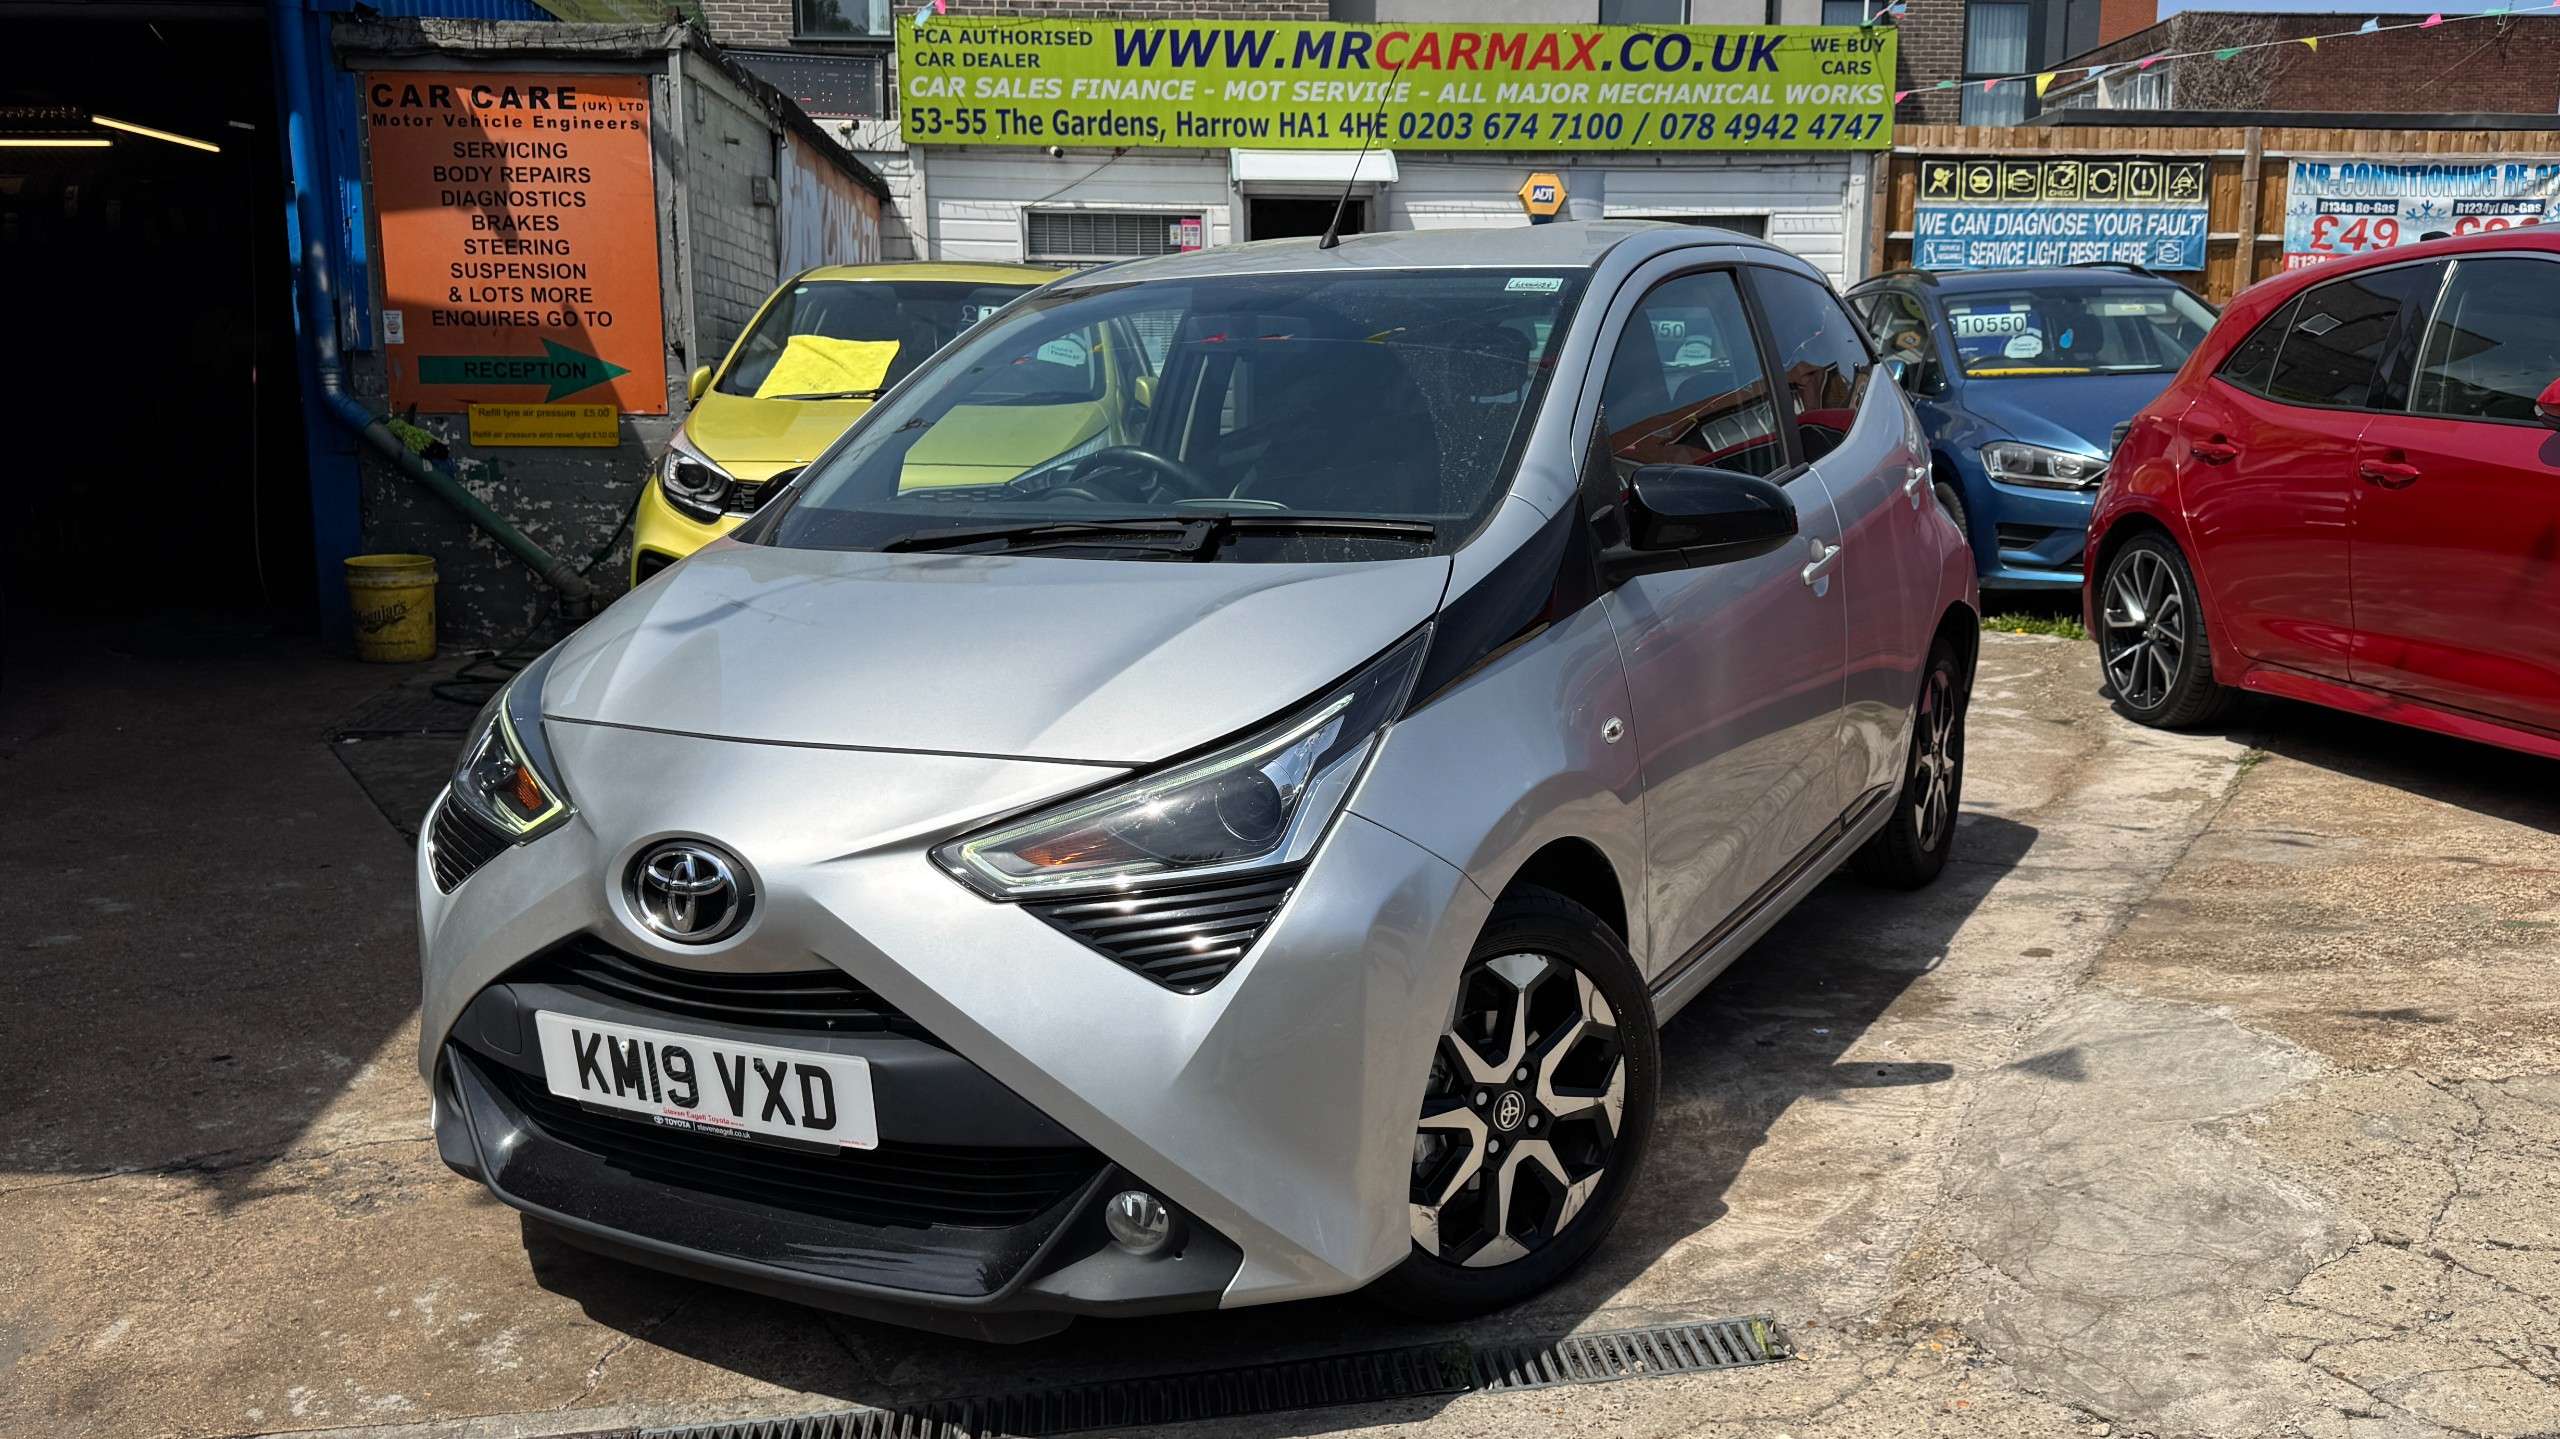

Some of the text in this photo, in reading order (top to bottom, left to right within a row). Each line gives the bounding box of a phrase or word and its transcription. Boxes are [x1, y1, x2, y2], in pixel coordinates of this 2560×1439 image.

[915, 30, 1092, 46] FCA AUTHORISED
[1811, 38, 1885, 53] WE BUY
[1113, 28, 1787, 73] WWW.MRCARMAX.CO.UK
[915, 51, 1041, 68] CAR DEALER
[1822, 60, 1872, 76] CARS
[371, 84, 644, 113] CAR CARE (UK) LTD
[910, 77, 969, 99] CAR
[975, 78, 1063, 100] SALES
[1072, 79, 1195, 101] FINANCE
[1225, 81, 1285, 102] MOT
[1292, 81, 1410, 103] SERVICE
[1437, 83, 1487, 103] ALL
[1496, 83, 1586, 104] MAJOR
[1598, 83, 1775, 106] MECHANICAL
[1785, 84, 1884, 106] WORKS
[372, 114, 640, 132] Motor Vehicle Engineers
[911, 107, 987, 135] 53-55
[996, 109, 1043, 136] The
[1053, 109, 1167, 144] Gardens,
[1176, 111, 1270, 138] Harrow
[1279, 112, 1329, 139] HA1
[1340, 112, 1388, 139] 4HE
[1399, 112, 1473, 140] 0203
[1484, 112, 1539, 140] 674
[1549, 112, 1623, 140] 7100
[1660, 112, 1715, 140] 078
[1726, 112, 1799, 140] 4942
[1808, 112, 1884, 140] 4747
[453, 142, 568, 159] SERVICING
[433, 166, 591, 184] BODY REPAIRS
[441, 191, 586, 208] DIAGNOSTICS
[1533, 186, 1555, 201] ADT
[2320, 201, 2396, 213] R134a Re-Gas
[2500, 202, 2542, 213] Re-Gas
[472, 215, 560, 232] BRAKES
[1919, 213, 2206, 235] WE CAN DIAGNOSE YOUR FAULT
[2311, 215, 2399, 250] £49
[464, 239, 570, 256] STEERING
[1970, 241, 2148, 265] SERVICE LIGHT RESET HERE
[450, 262, 587, 279] SUSPENSION
[448, 286, 593, 303] & LOTS MORE
[432, 310, 612, 328] ENQUIRES GO TO
[1961, 316, 2025, 334] 10550
[464, 362, 587, 379] RECEPTION
[479, 408, 501, 417] Refill
[572, 1028, 837, 1131] KM19 VXD
[665, 1118, 691, 1129] TOYOTA
